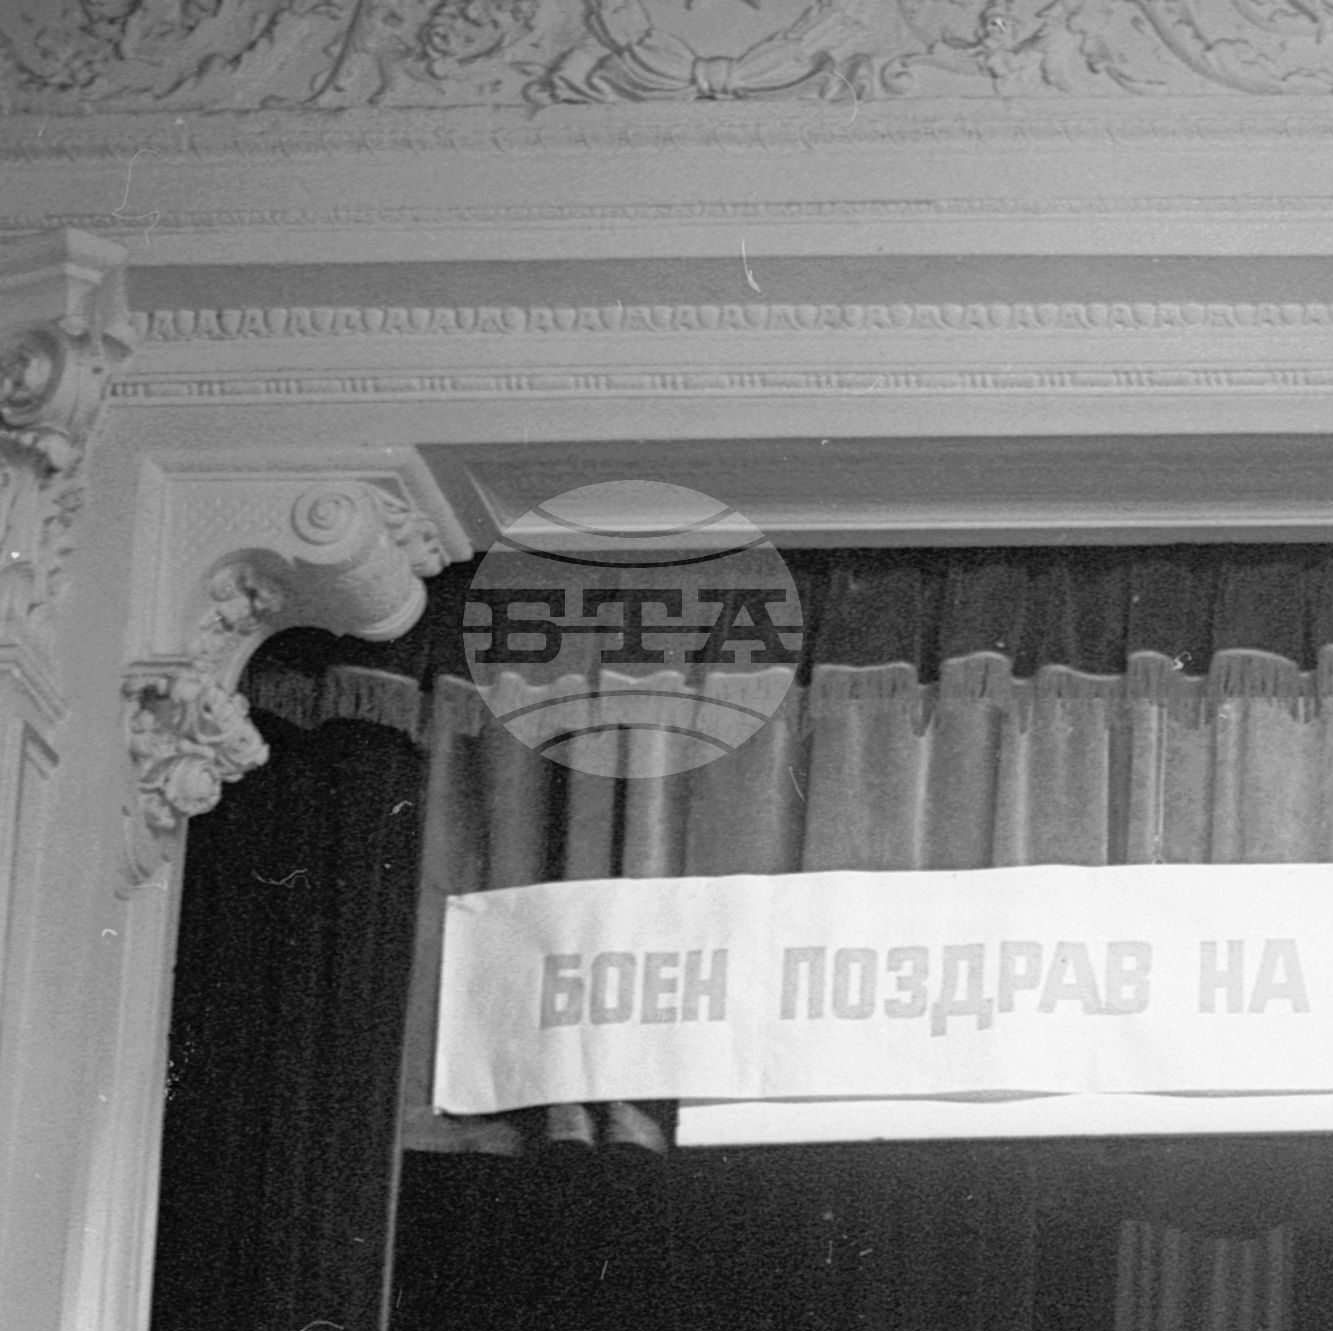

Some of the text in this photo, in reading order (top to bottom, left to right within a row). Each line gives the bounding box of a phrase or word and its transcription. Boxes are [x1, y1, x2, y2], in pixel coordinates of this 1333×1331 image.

[540, 949, 728, 1029] БОЕН
[779, 940, 1153, 1037] ПОЗДРАВ
[1198, 939, 1311, 1014] НА
